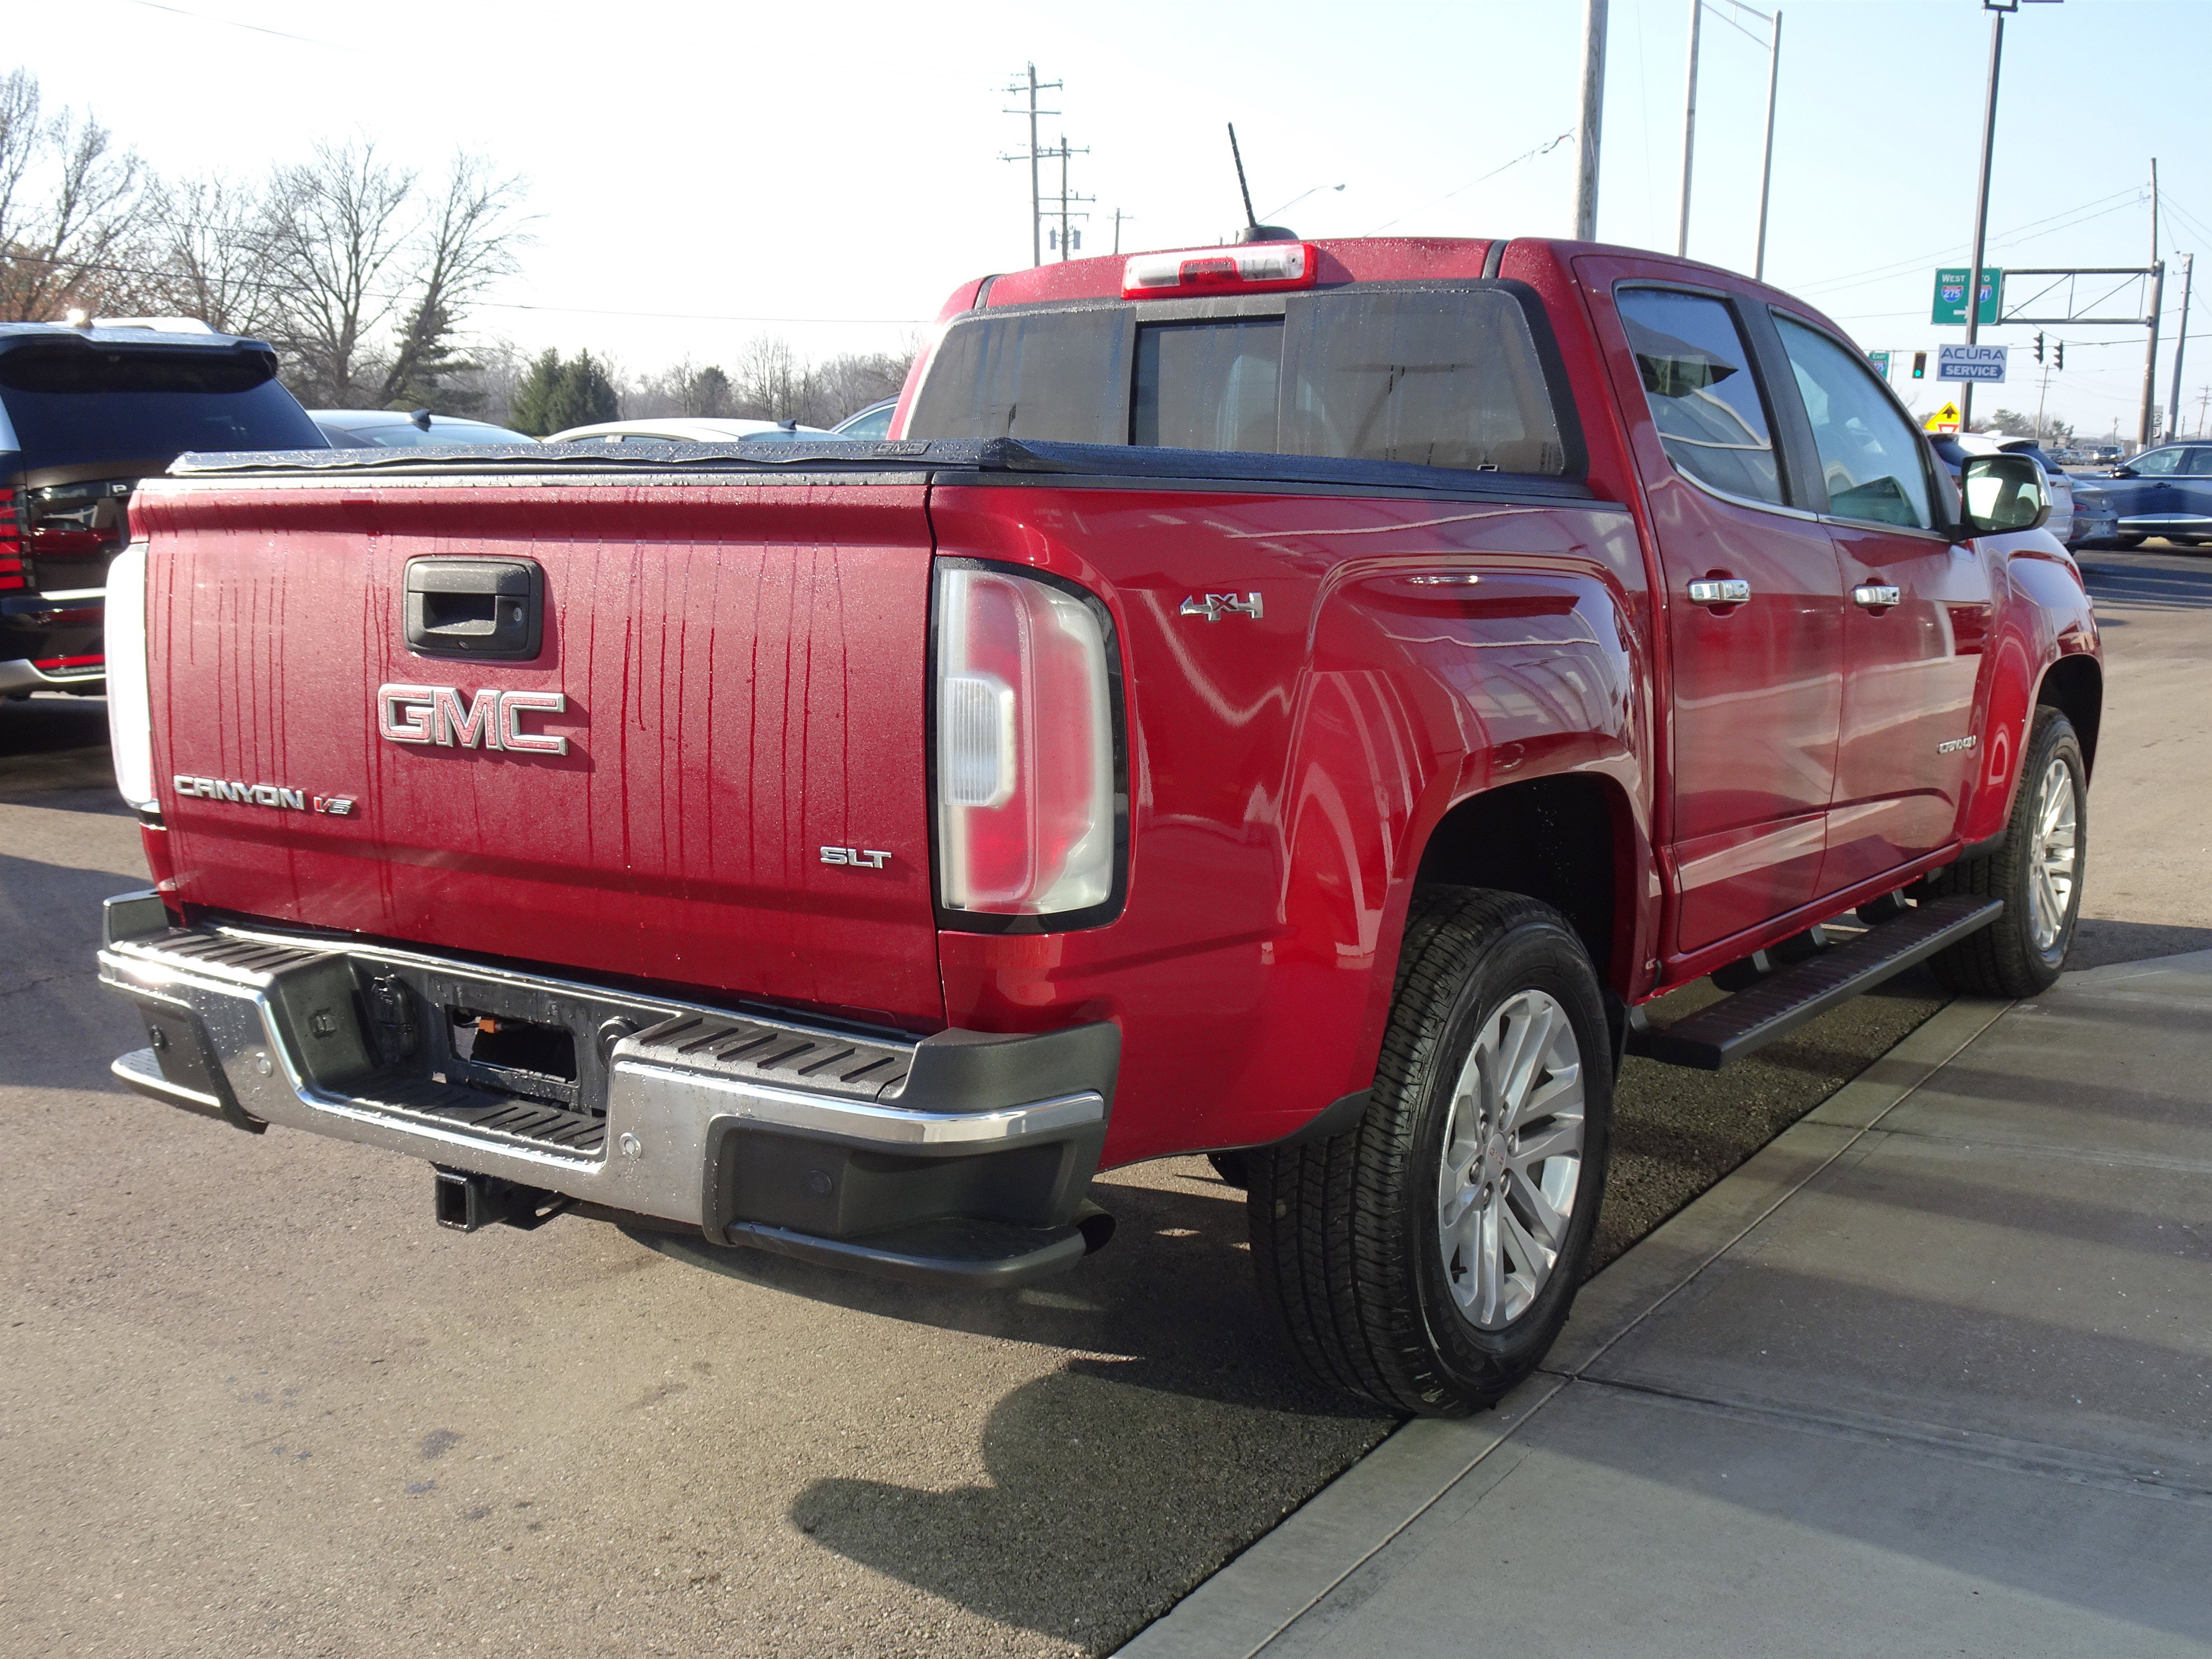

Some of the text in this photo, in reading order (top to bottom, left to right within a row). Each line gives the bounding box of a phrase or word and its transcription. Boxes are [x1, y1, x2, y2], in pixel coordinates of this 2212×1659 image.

[1944, 289, 1960, 298] 275
[1941, 348, 2005, 360] ACURA
[1945, 365, 1998, 376] SERVICE
[877, 443, 923, 452] GMC
[378, 683, 568, 756] GMC
[173, 775, 353, 814] CANYON V6
[820, 846, 892, 868] SLT
